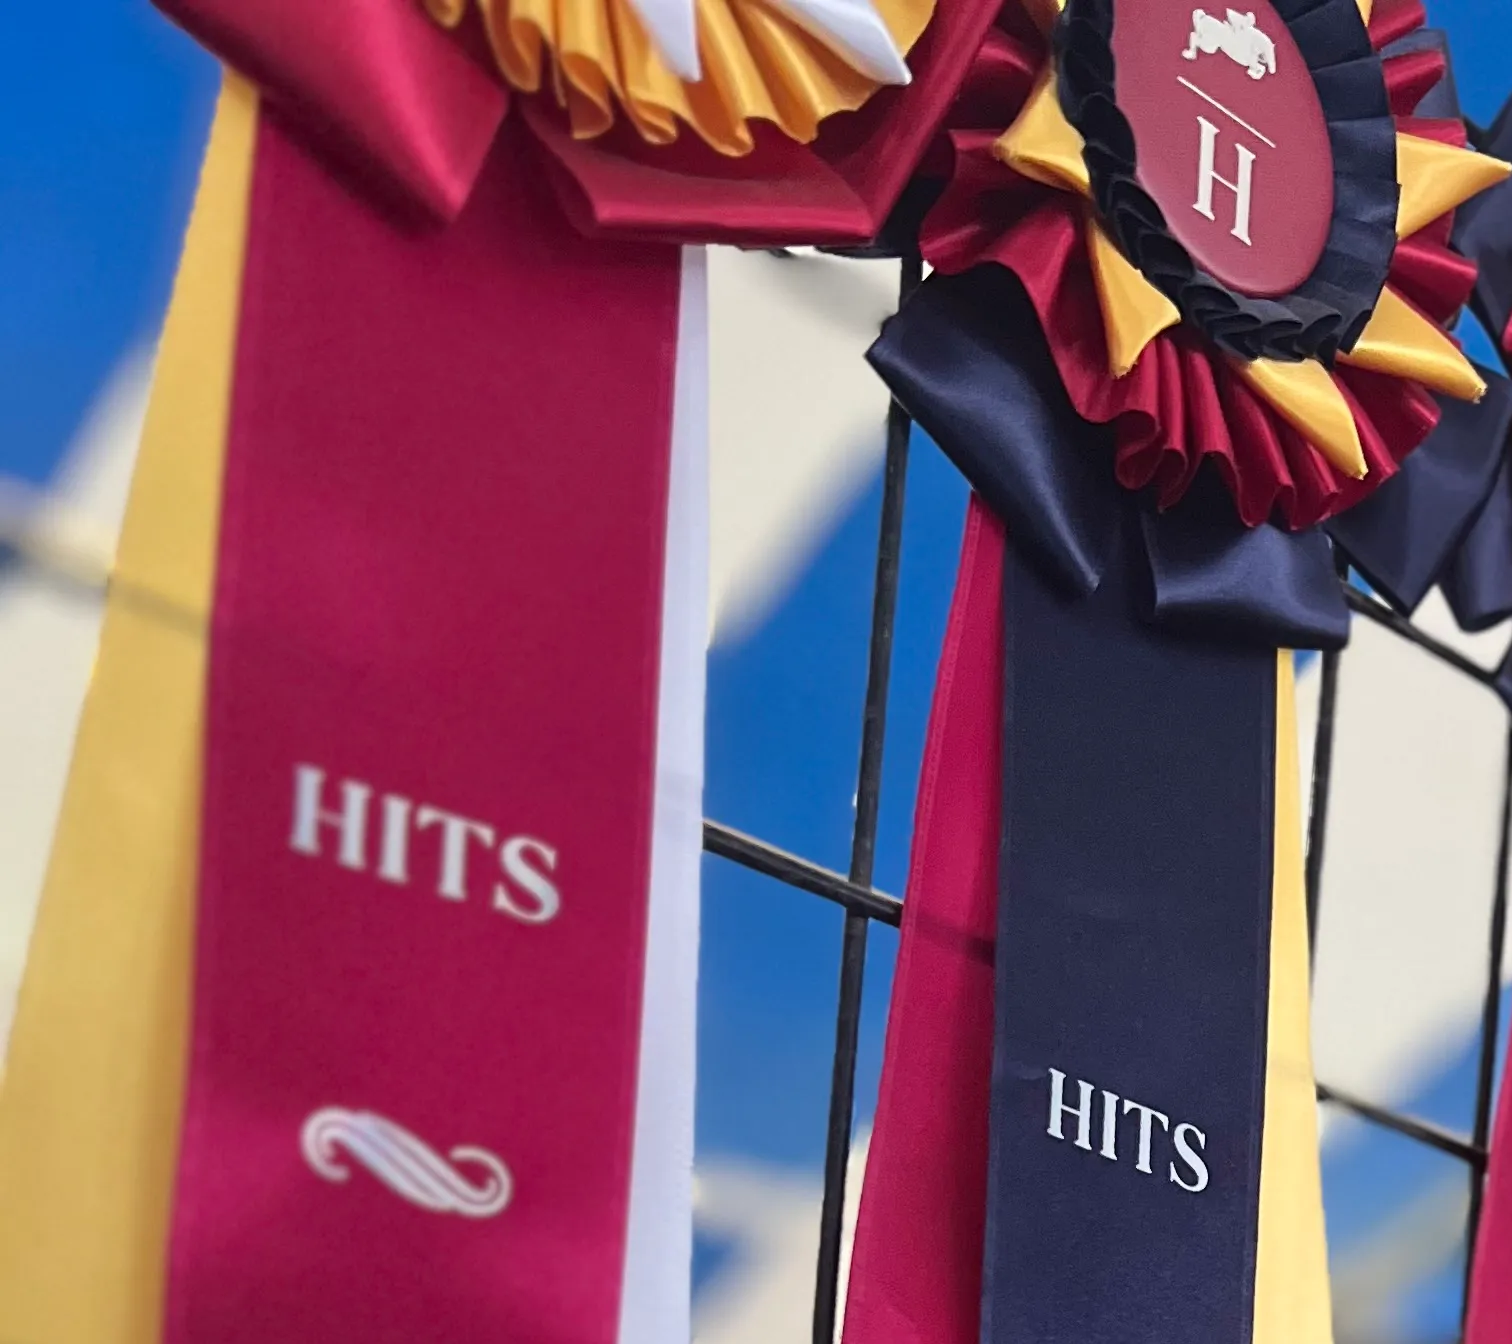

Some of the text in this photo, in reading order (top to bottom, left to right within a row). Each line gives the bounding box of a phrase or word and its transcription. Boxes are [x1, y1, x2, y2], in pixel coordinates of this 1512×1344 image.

[1192, 115, 1257, 247] H
[289, 763, 561, 924] HITS
[1046, 1067, 1208, 1191] HITS
